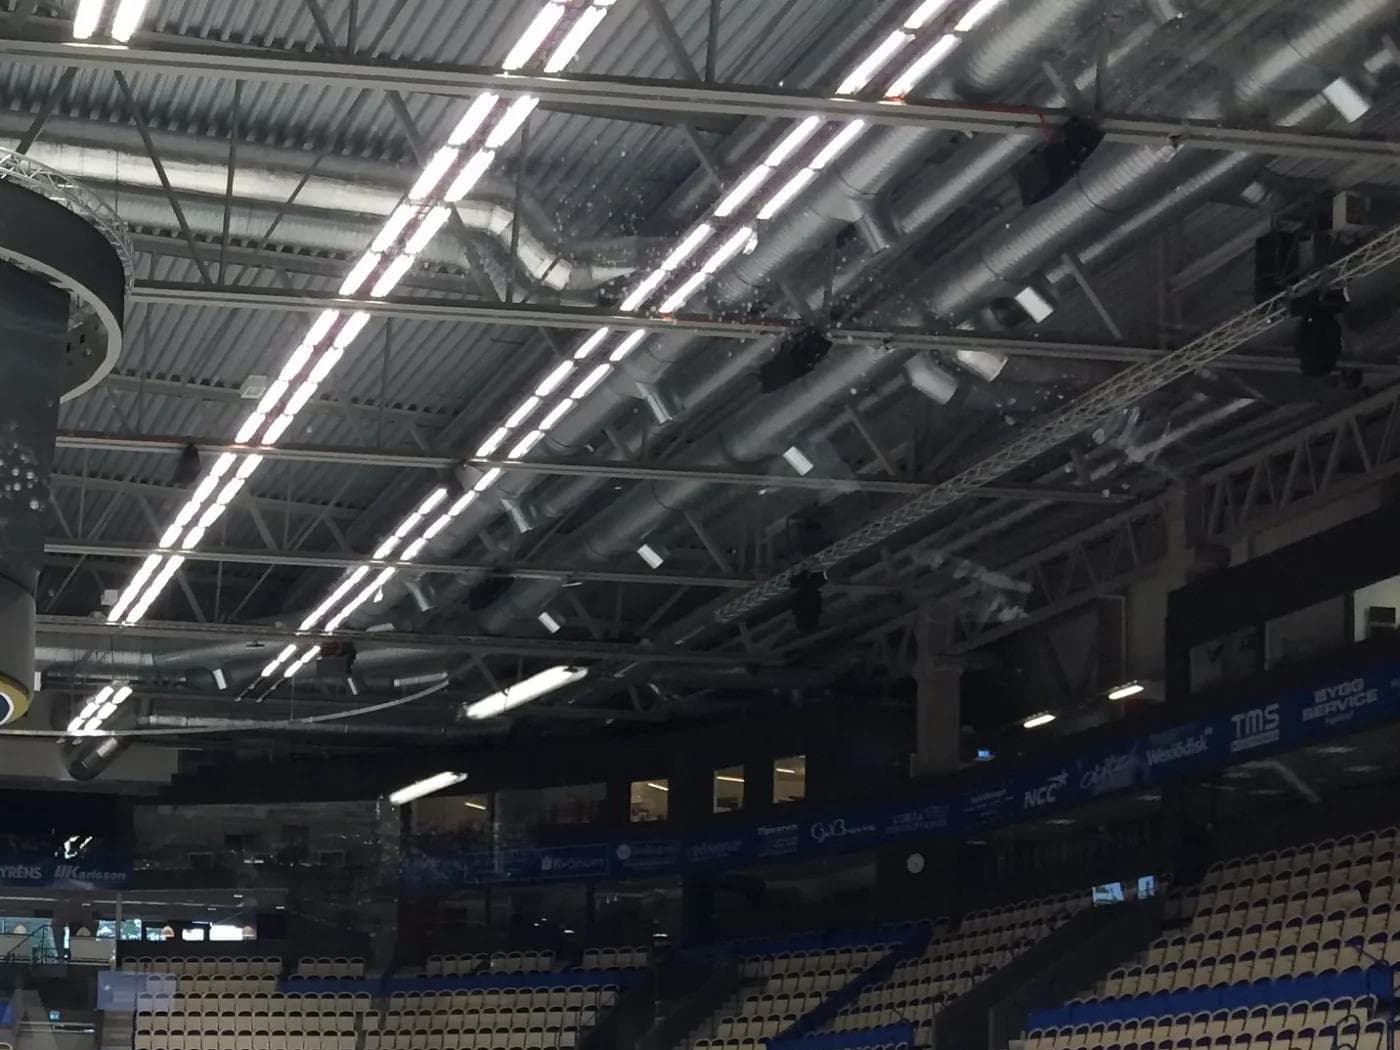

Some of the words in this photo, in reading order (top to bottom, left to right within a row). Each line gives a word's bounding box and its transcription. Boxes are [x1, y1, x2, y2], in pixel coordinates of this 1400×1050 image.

[1230, 702, 1280, 739] TMS
[1301, 688, 1378, 722] SERVICE
[1023, 782, 1058, 809] NCC
